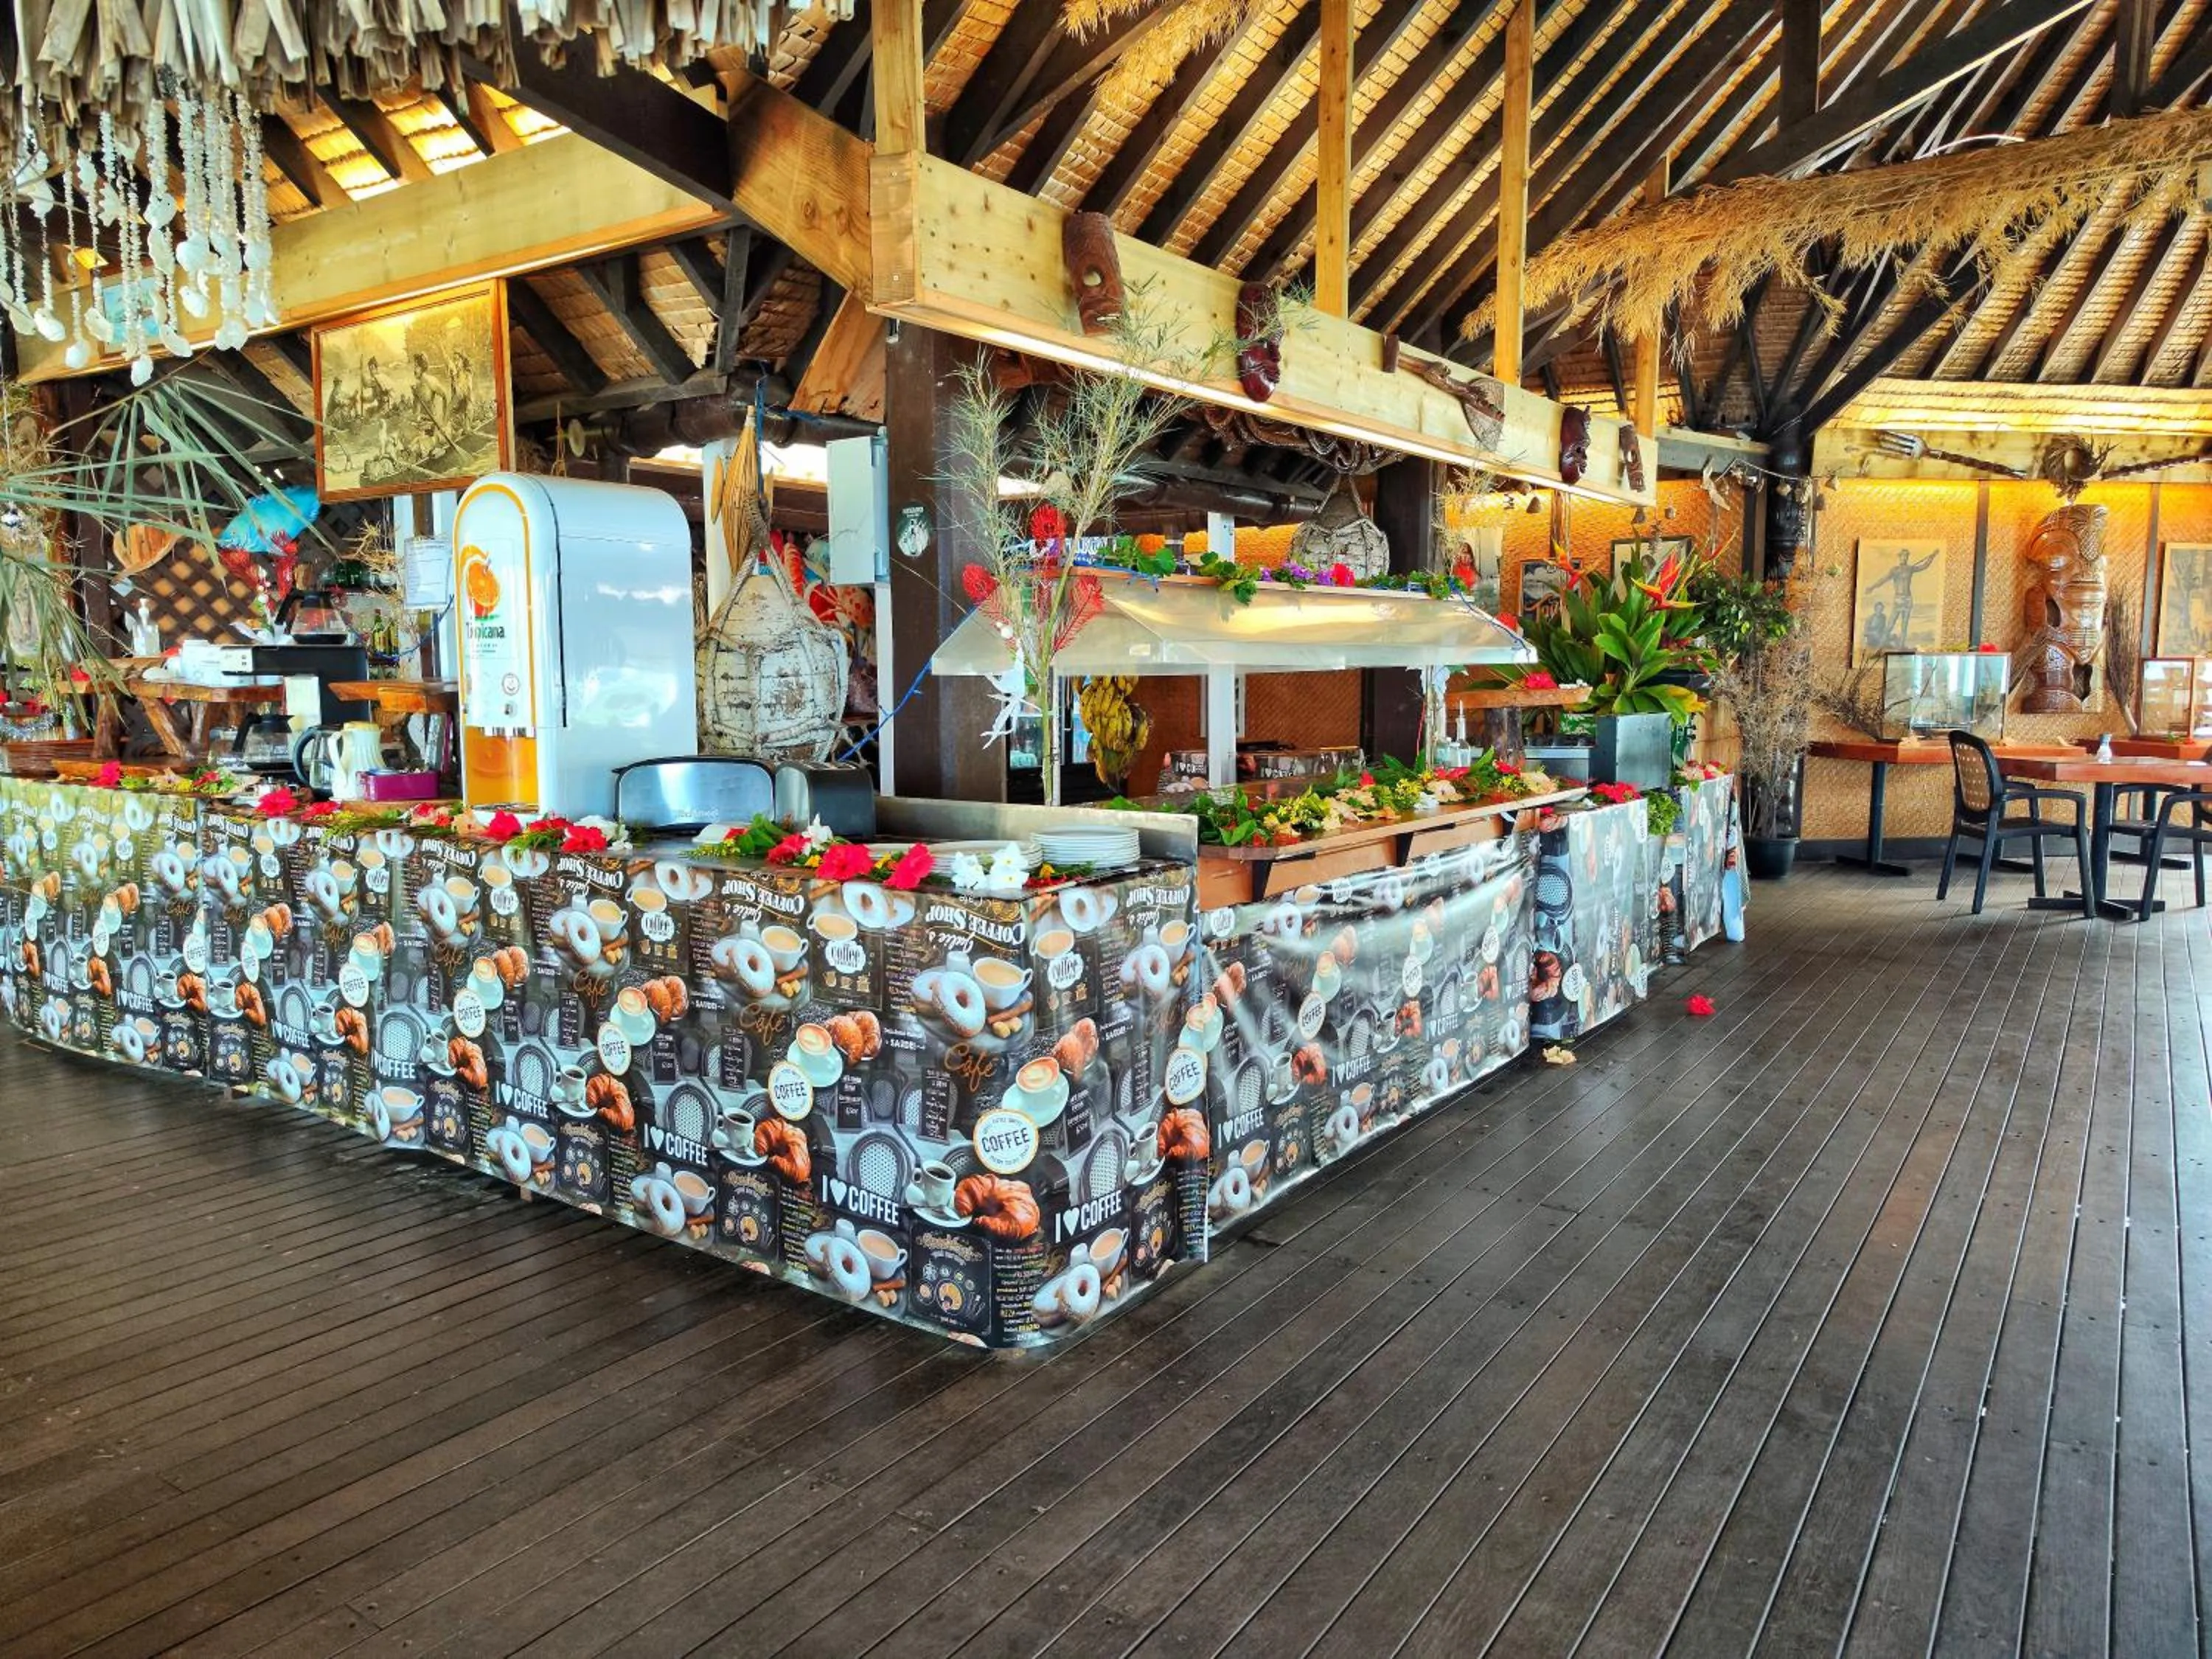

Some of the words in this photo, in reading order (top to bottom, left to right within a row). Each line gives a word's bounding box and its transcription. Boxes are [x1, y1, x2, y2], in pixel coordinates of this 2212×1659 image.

[722, 880, 756, 902] SHOP
[757, 887, 804, 915] COFFEE
[925, 905, 967, 931] SHOP
[968, 914, 1026, 946] COFFEE
[739, 1003, 786, 1046] Café
[1301, 1002, 1324, 1026] COFFEE
[945, 1043, 1000, 1092] Café
[1169, 1061, 1200, 1091] COFFEE
[1332, 1065, 1336, 1088] I
[1346, 1054, 1371, 1081] COFFEE
[495, 1080, 500, 1104] I
[514, 1088, 549, 1119] COFFEE
[774, 1082, 807, 1099] COFFEE
[644, 1122, 649, 1148] I
[666, 1132, 708, 1166] COFFEE
[981, 1127, 1029, 1152] COFFEE
[1217, 1123, 1222, 1150] I
[1234, 1107, 1265, 1140] COFFEE
[822, 1174, 828, 1203] I
[849, 1185, 899, 1225] COFFEE
[1055, 1213, 1061, 1244] I
[1080, 1189, 1121, 1231] COFFEE
